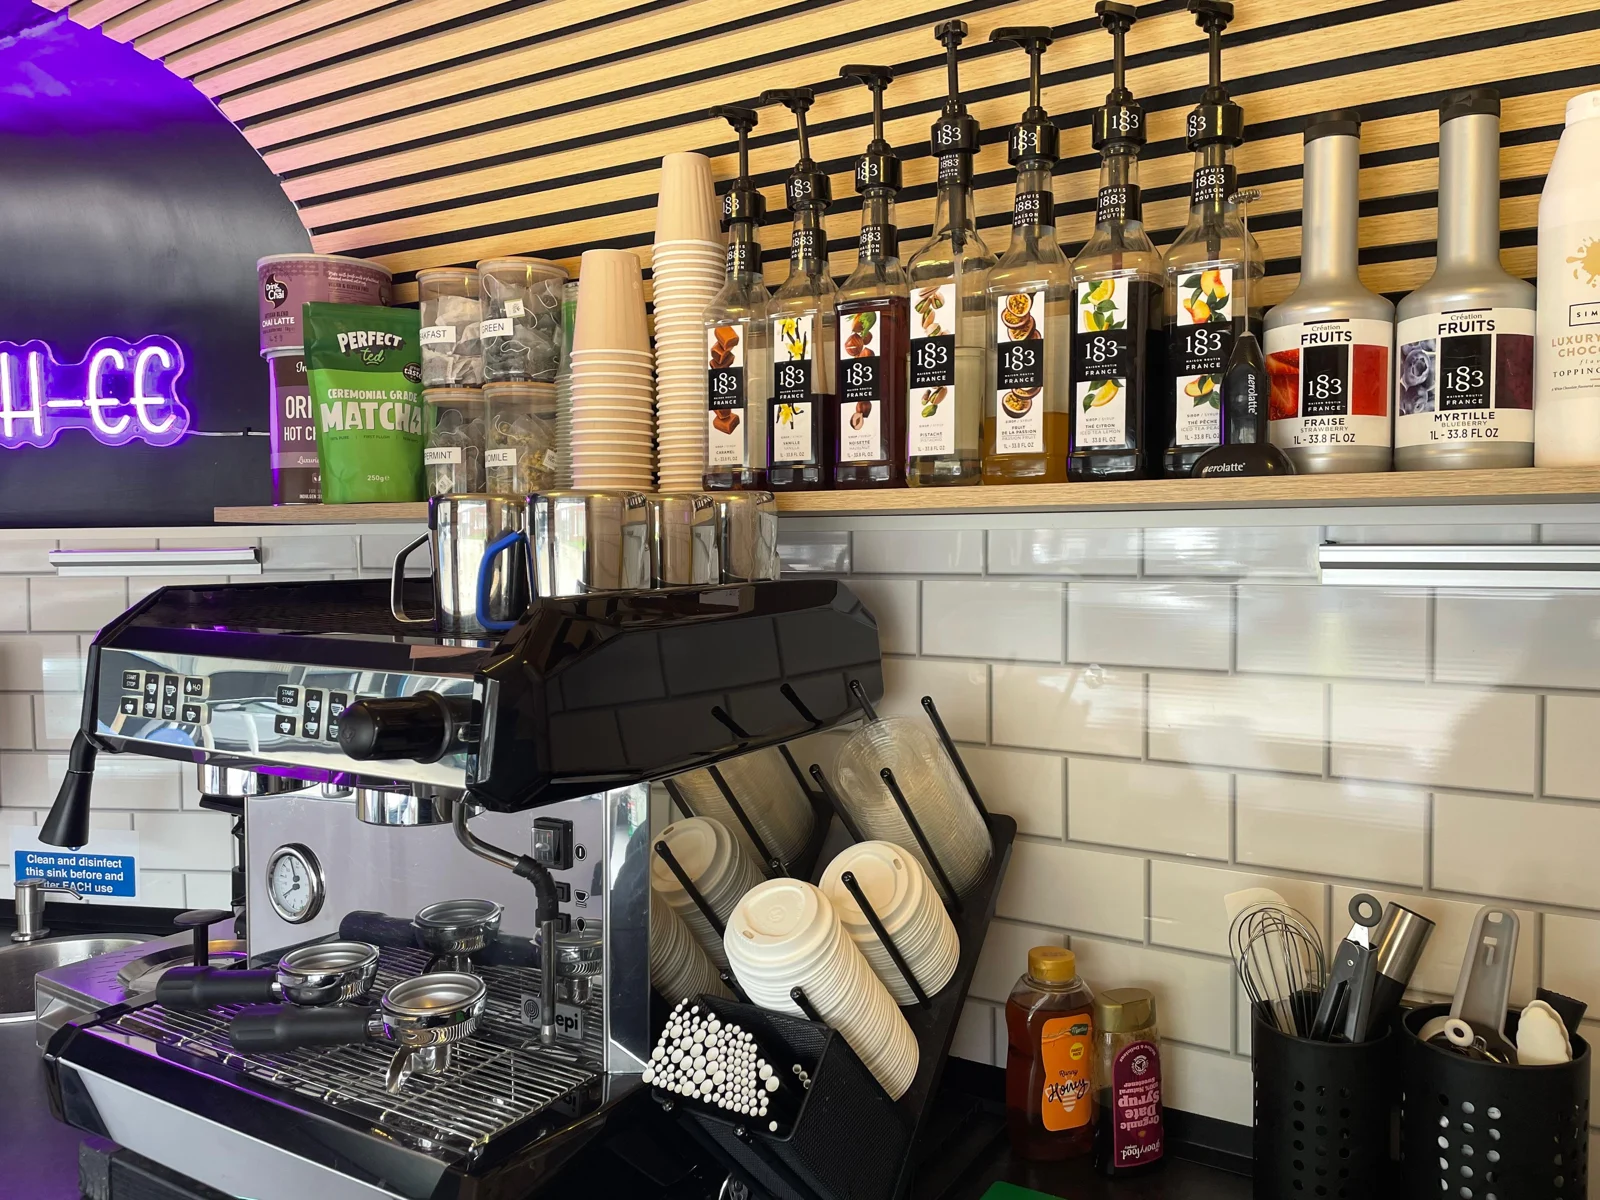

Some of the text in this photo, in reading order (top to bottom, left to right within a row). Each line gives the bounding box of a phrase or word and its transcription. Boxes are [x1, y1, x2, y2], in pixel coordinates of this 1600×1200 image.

[940, 159, 959, 169] 1883
[1196, 167, 1225, 178] DEPUIS
[1195, 173, 1225, 189] 1883
[1100, 187, 1126, 197] DEPUIS
[1195, 188, 1224, 197] MAISON
[1016, 194, 1040, 202] DEPUIS
[1100, 193, 1126, 208] 1883
[1015, 200, 1040, 214] 1883
[1099, 207, 1125, 215] MAISON
[1015, 212, 1039, 221] MAISON
[792, 236, 813, 248] 1883
[265, 283, 279, 291] Drink
[268, 289, 285, 300] Chai
[1450, 313, 1483, 321] Création
[1576, 310, 1598, 318] SIM
[262, 317, 295, 328] CHAI LATTE
[1438, 319, 1495, 335] FRUITS
[482, 323, 505, 334] GREEN
[337, 331, 403, 354] PERFECT
[1301, 331, 1352, 345] FRUITS
[1551, 333, 1600, 348] LUXURY
[360, 348, 385, 363] ted
[1558, 345, 1600, 358] CHOC
[1185, 362, 1221, 371] FRANCE
[916, 375, 946, 383] FRANCE
[328, 388, 418, 403] CEREMONIAL GRADE
[1248, 373, 1257, 414] aerolatte
[1446, 398, 1483, 406] FRANCE
[320, 401, 422, 436] MATCHA
[1434, 411, 1495, 422] MYRTILLE
[1304, 418, 1345, 427] FRAISE
[284, 426, 302, 441] HOT
[1300, 426, 1349, 434] STRAWBERRY
[1430, 431, 1439, 440] 1L
[1447, 429, 1468, 439] 33.8
[1471, 429, 1483, 438] FL
[1485, 428, 1499, 438] OZ
[1294, 436, 1301, 445] 1L
[1309, 434, 1327, 444] 33.8
[1330, 434, 1340, 443] FL
[1343, 433, 1356, 443] OZ
[1202, 463, 1244, 473] aerolatte
[26, 854, 122, 868] Clean and disinfect
[25, 867, 124, 881] this sink before and
[62, 882, 92, 892] EACH
[94, 884, 113, 893] use
[1059, 1069, 1079, 1077] Runny
[1048, 1078, 1087, 1103] Honey
[1119, 1086, 1144, 1095] Natural
[1118, 1090, 1160, 1108] Syrup
[1125, 1104, 1156, 1120] Date
[1120, 1114, 1159, 1131] Organic
